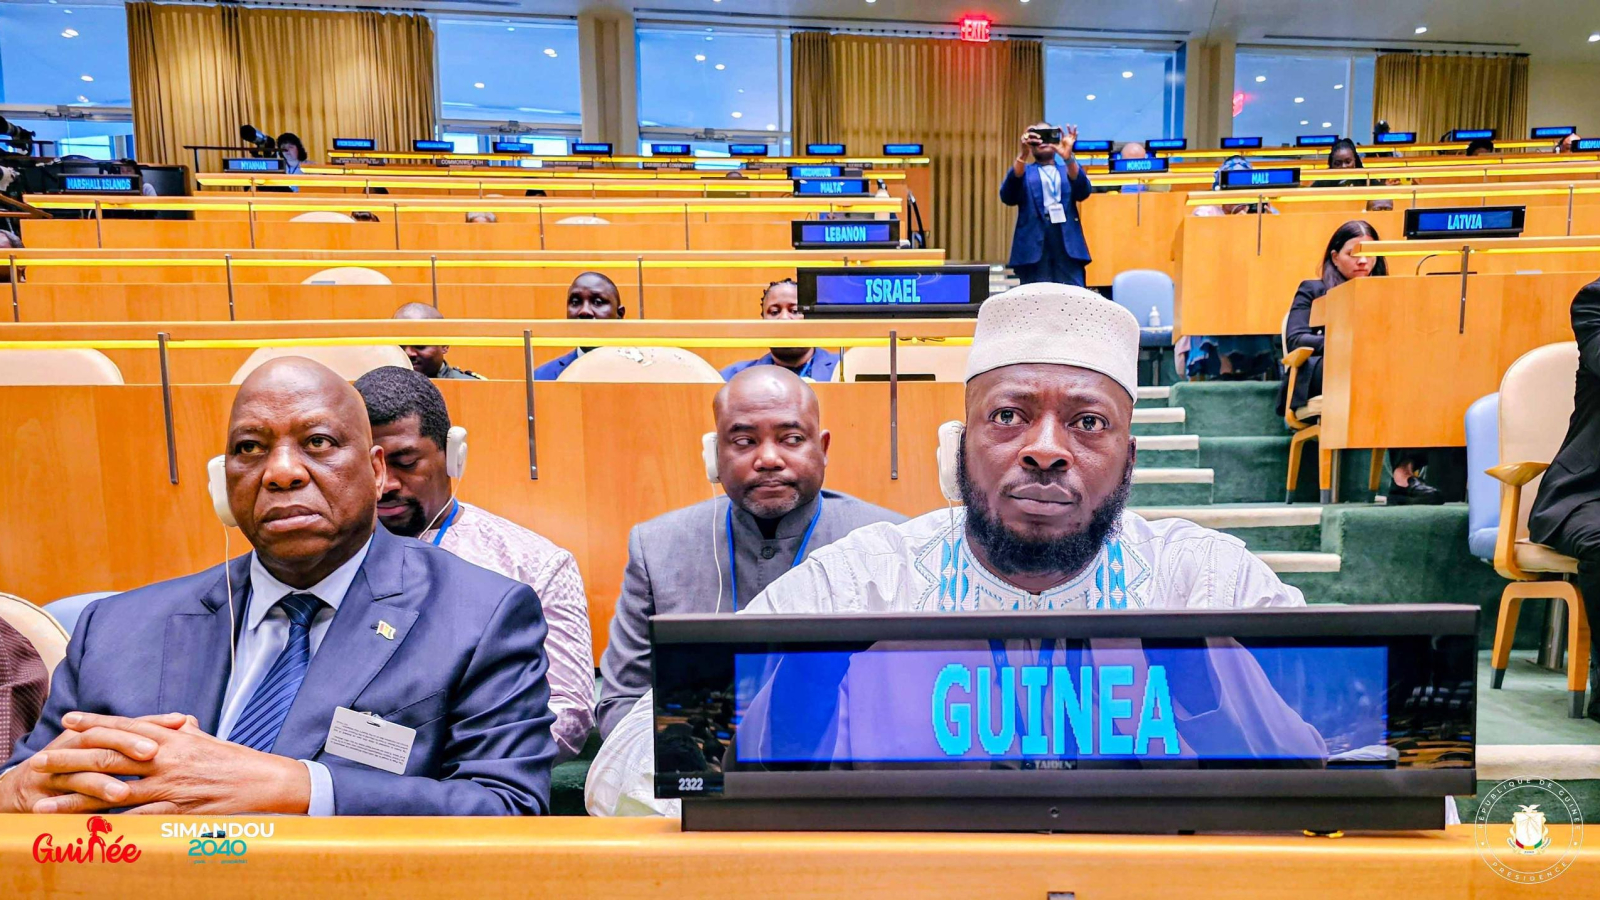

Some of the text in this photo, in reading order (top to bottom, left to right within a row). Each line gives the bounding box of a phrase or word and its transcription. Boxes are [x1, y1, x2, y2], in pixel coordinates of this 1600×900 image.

[964, 20, 987, 40] EXIT
[240, 160, 267, 170] MYANMAR
[1126, 160, 1152, 171] MOROCCO
[67, 177, 131, 190] MARSHALL ISLANDS
[1251, 172, 1270, 185] MALI
[820, 181, 842, 194] MALTA
[1447, 213, 1483, 230] LATVIA
[825, 226, 866, 242] LEBANON
[865, 278, 921, 303] ISRAEL
[931, 663, 1181, 756] GUINEA
[678, 777, 704, 791] 2322
